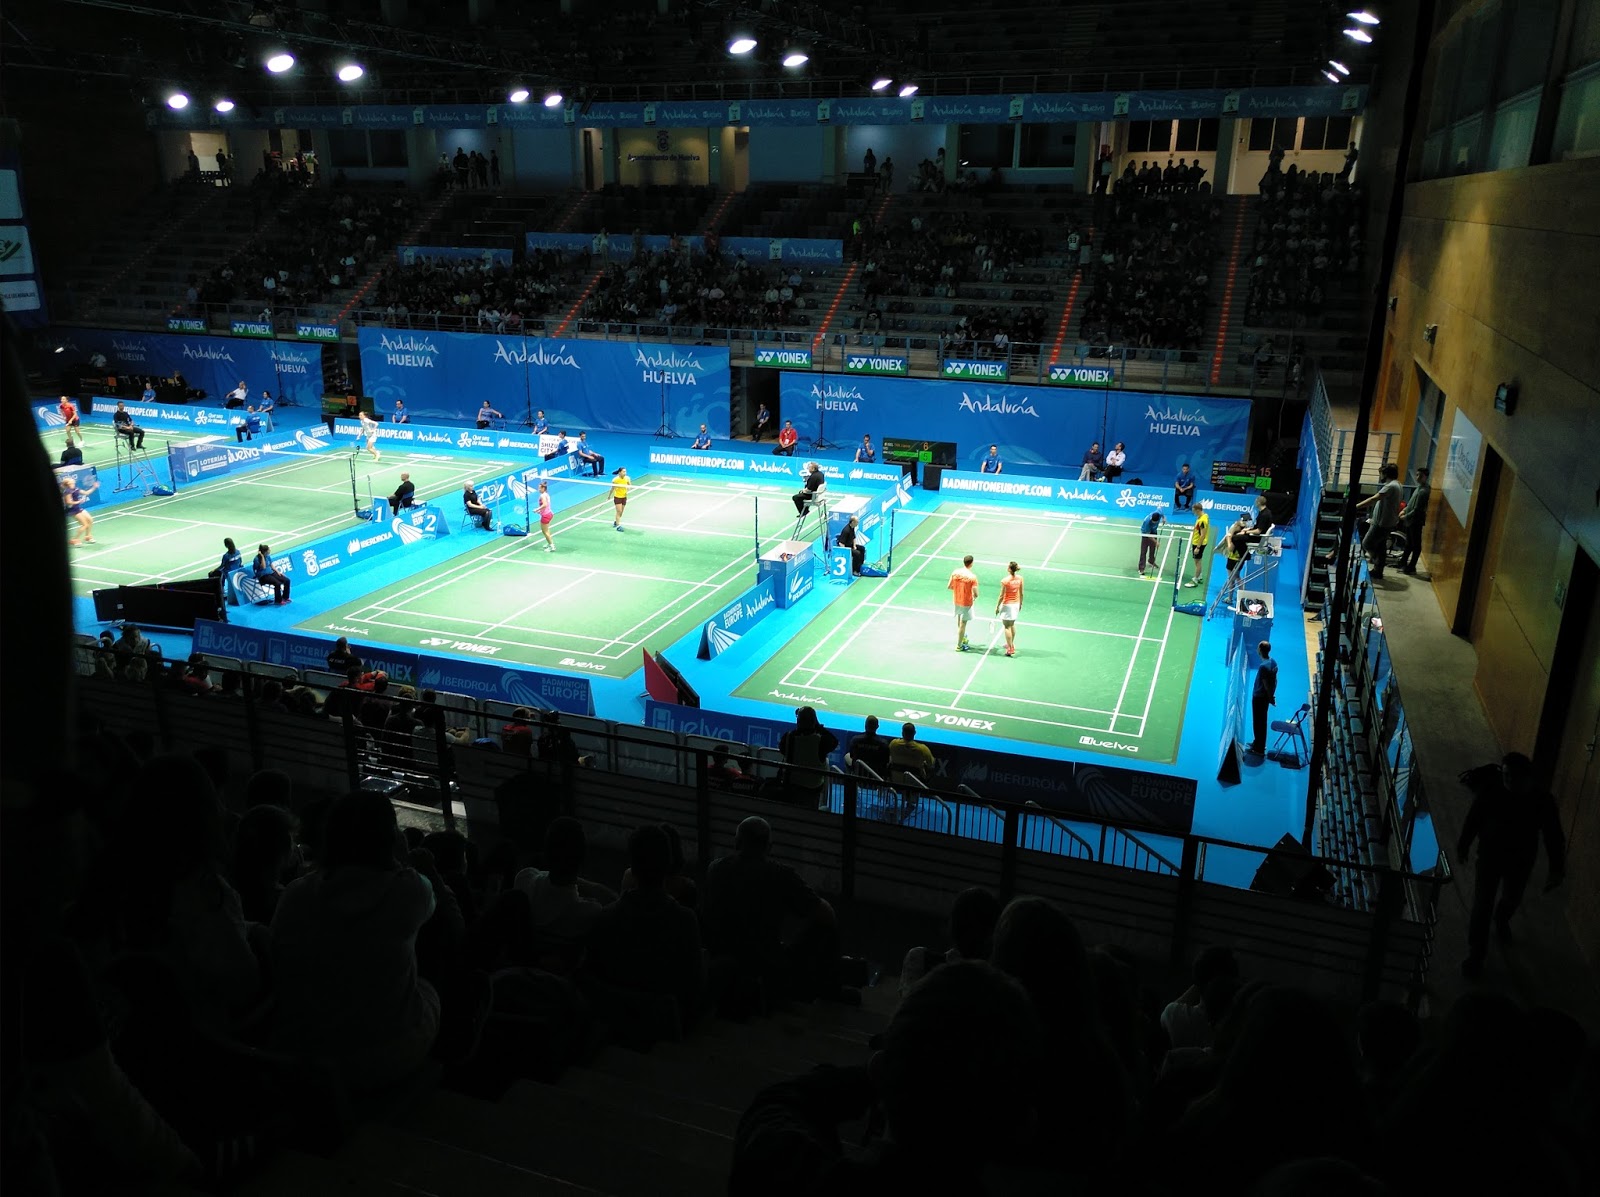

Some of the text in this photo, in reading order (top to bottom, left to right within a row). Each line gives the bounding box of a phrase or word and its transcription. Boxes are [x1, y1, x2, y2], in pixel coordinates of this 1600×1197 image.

[180, 319, 206, 331] YONEX
[245, 324, 270, 335] YONEX
[312, 326, 337, 338] YONEX
[380, 334, 439, 354] Andalucía
[183, 343, 235, 363] Andalucía
[270, 350, 310, 365] Andalucía
[387, 353, 433, 368] HUELVA
[494, 340, 580, 369] Andalucía
[635, 348, 704, 371] Andalucía
[777, 352, 807, 365] YONEX
[275, 363, 307, 375] HUELVA
[869, 358, 902, 372] YONEX
[968, 363, 1002, 377] YONEX
[643, 370, 696, 385] HUELVA
[1074, 369, 1109, 382] YONEX
[811, 383, 864, 401] Andalucía
[93, 403, 158, 417] BADMINTEUROPE.COM
[816, 400, 858, 412] HUELVA
[958, 392, 1040, 418] Andalucía
[1144, 405, 1209, 425] Andalucía
[1150, 422, 1200, 436] HUELVA
[417, 431, 453, 444] Andalucía
[510, 441, 538, 450] IBERDROLA
[923, 442, 929, 451] 6
[200, 454, 227, 465] LOTERÍAS
[650, 452, 792, 475] BADMINTONEUROPE.COM Andalucía
[864, 473, 899, 482] IBERDROLA
[1260, 467, 1271, 477] 15
[942, 477, 1108, 503] BADMINTONEUROPE.COM Andalucía
[1258, 478, 1268, 488] 21
[1138, 492, 1150, 500] Que
[1146, 499, 1169, 508] Huelva
[375, 506, 383, 523] 1
[425, 514, 436, 532] 2
[360, 531, 393, 549] IBERDROLA
[319, 557, 340, 570] HUELVA
[833, 556, 846, 576] 3
[746, 589, 775, 620] Andalucía
[724, 608, 743, 629] EUROPE
[324, 623, 369, 635] Andalucía
[198, 625, 259, 657] Huelva
[450, 641, 502, 655] YONEX
[370, 659, 413, 682] YONEX
[559, 657, 607, 671] Huelva
[442, 675, 497, 693] IBERDROLA
[541, 677, 588, 690] BADMINTON
[541, 685, 587, 701] EUROPE
[767, 689, 828, 706] Andalucía
[652, 706, 734, 740] Huelva
[934, 713, 996, 731] YONEX
[1079, 735, 1139, 753] Huelva
[990, 770, 1068, 793] IBERDROLA
[1131, 775, 1194, 792] BADMINTON
[1130, 784, 1193, 804] EUROPE
